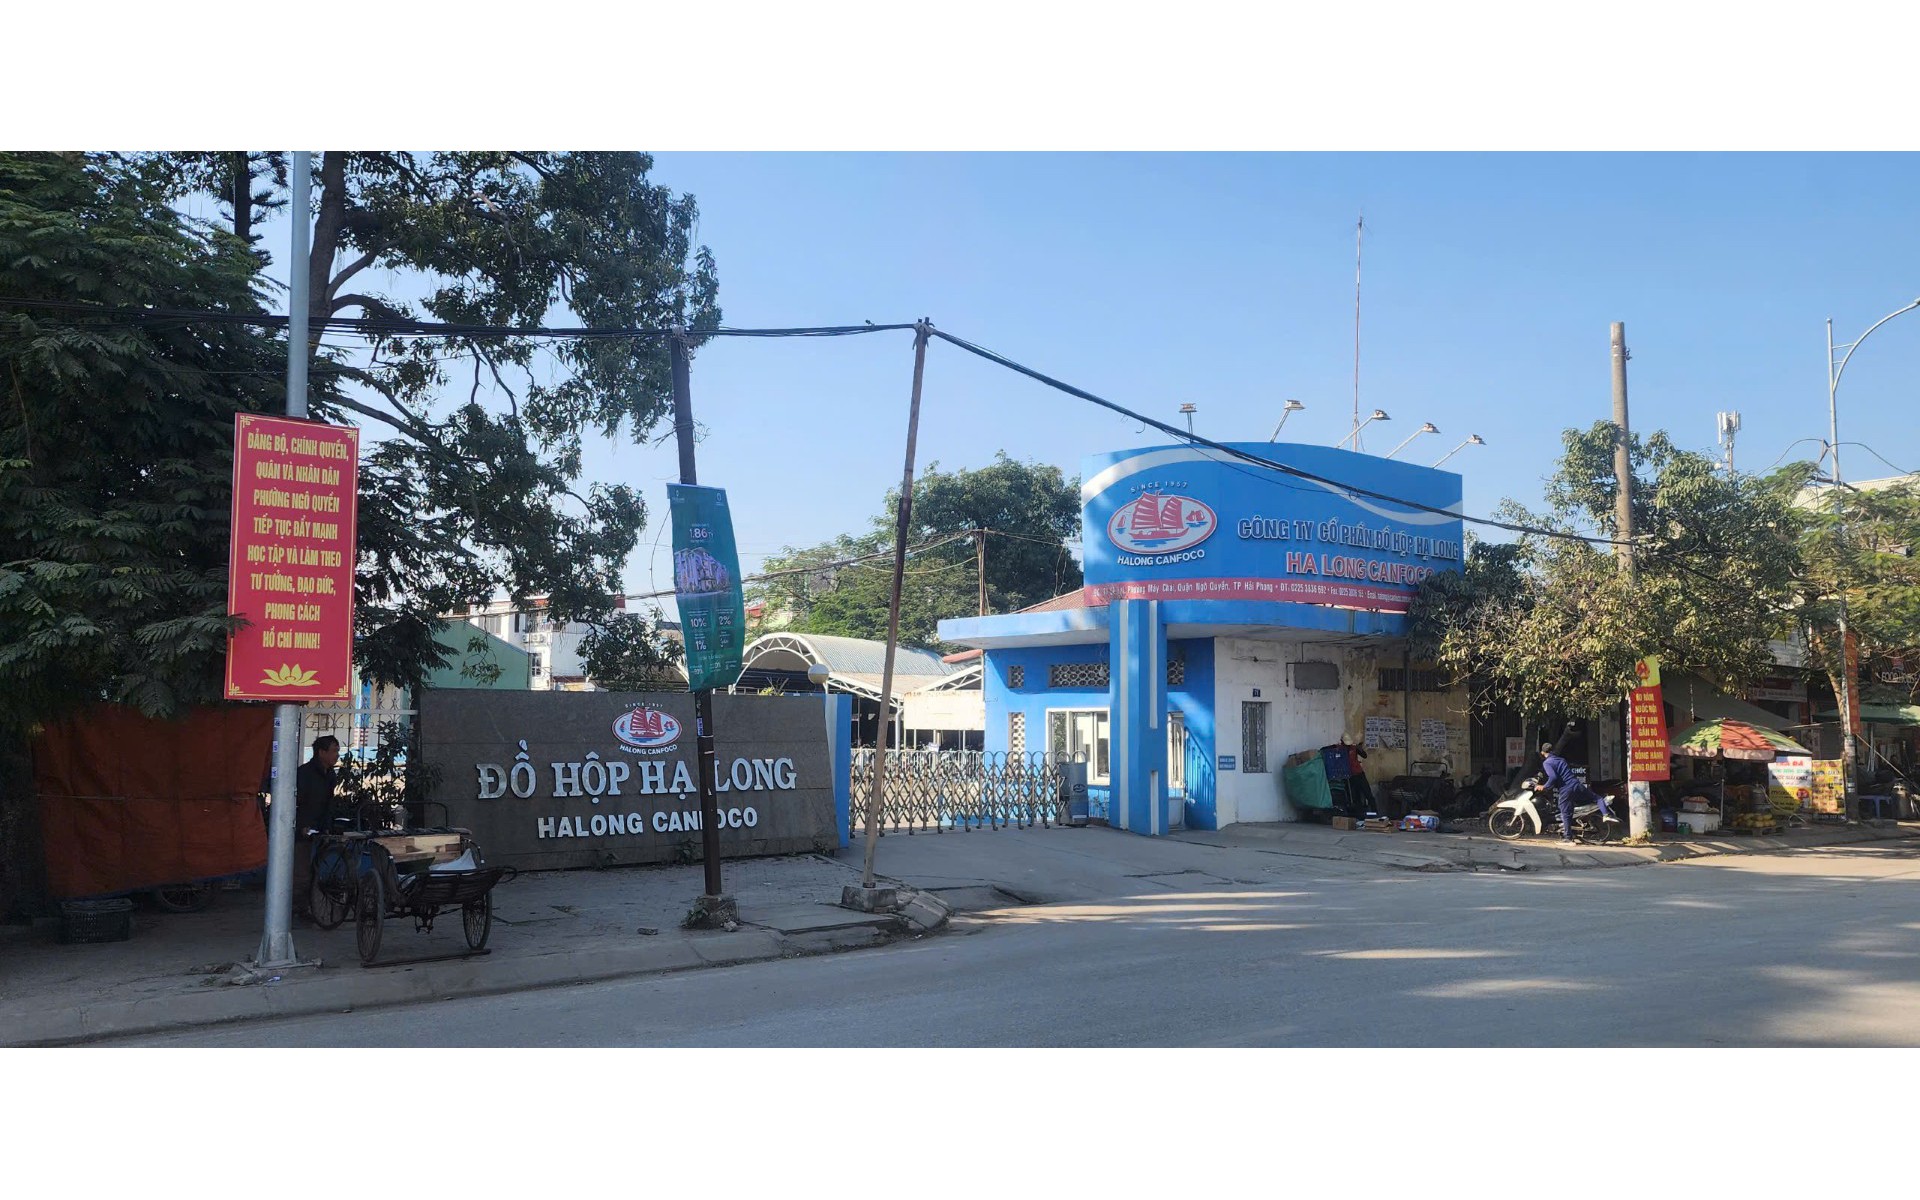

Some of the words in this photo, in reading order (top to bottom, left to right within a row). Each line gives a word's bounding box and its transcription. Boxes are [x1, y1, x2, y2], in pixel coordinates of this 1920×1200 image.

[247, 428, 272, 451] ĐẢNG
[274, 433, 289, 455] BỘ,
[291, 435, 317, 455] CHÍNH
[256, 459, 280, 479] QUÂN
[282, 461, 294, 480] VÀ
[295, 463, 320, 483] NHÂN
[322, 466, 339, 486] DÂN
[253, 487, 290, 508] PHƯỜNG
[292, 491, 310, 510] NGÔ
[1130, 481, 1159, 493] SINCE
[254, 513, 272, 535] TIẾP
[275, 519, 292, 539] TỤC
[293, 515, 311, 538] ĐẨY
[312, 522, 338, 542] MẠNH
[1237, 514, 1290, 539] CÔNG
[1293, 520, 1314, 540] TY
[1392, 530, 1413, 557] HỘP
[1414, 536, 1430, 561] HẠ
[1431, 538, 1460, 560] LONG
[247, 545, 265, 566] HỌC
[267, 543, 285, 566] TẬP
[286, 545, 298, 564] VÀ
[300, 546, 318, 566] LÀM
[320, 550, 341, 567] THEO
[1117, 555, 1153, 566] HALONG
[1155, 549, 1205, 565] CANFOCO
[1286, 551, 1318, 575] HA
[1321, 553, 1367, 580] LONG
[251, 571, 263, 590] TƯ
[297, 576, 315, 597] ĐẠO
[317, 575, 336, 596] ĐỨC,
[265, 602, 296, 620] PHONG
[298, 601, 320, 621] CÁCH
[277, 628, 292, 648] CHÍ
[619, 744, 646, 755] HALONG
[647, 744, 678, 754] CANFOCO
[476, 739, 537, 799] ĐỒ
[551, 751, 630, 804] HỘP
[638, 760, 697, 800] HẠ
[714, 757, 797, 792] LONG
[537, 812, 644, 839] HALONG
